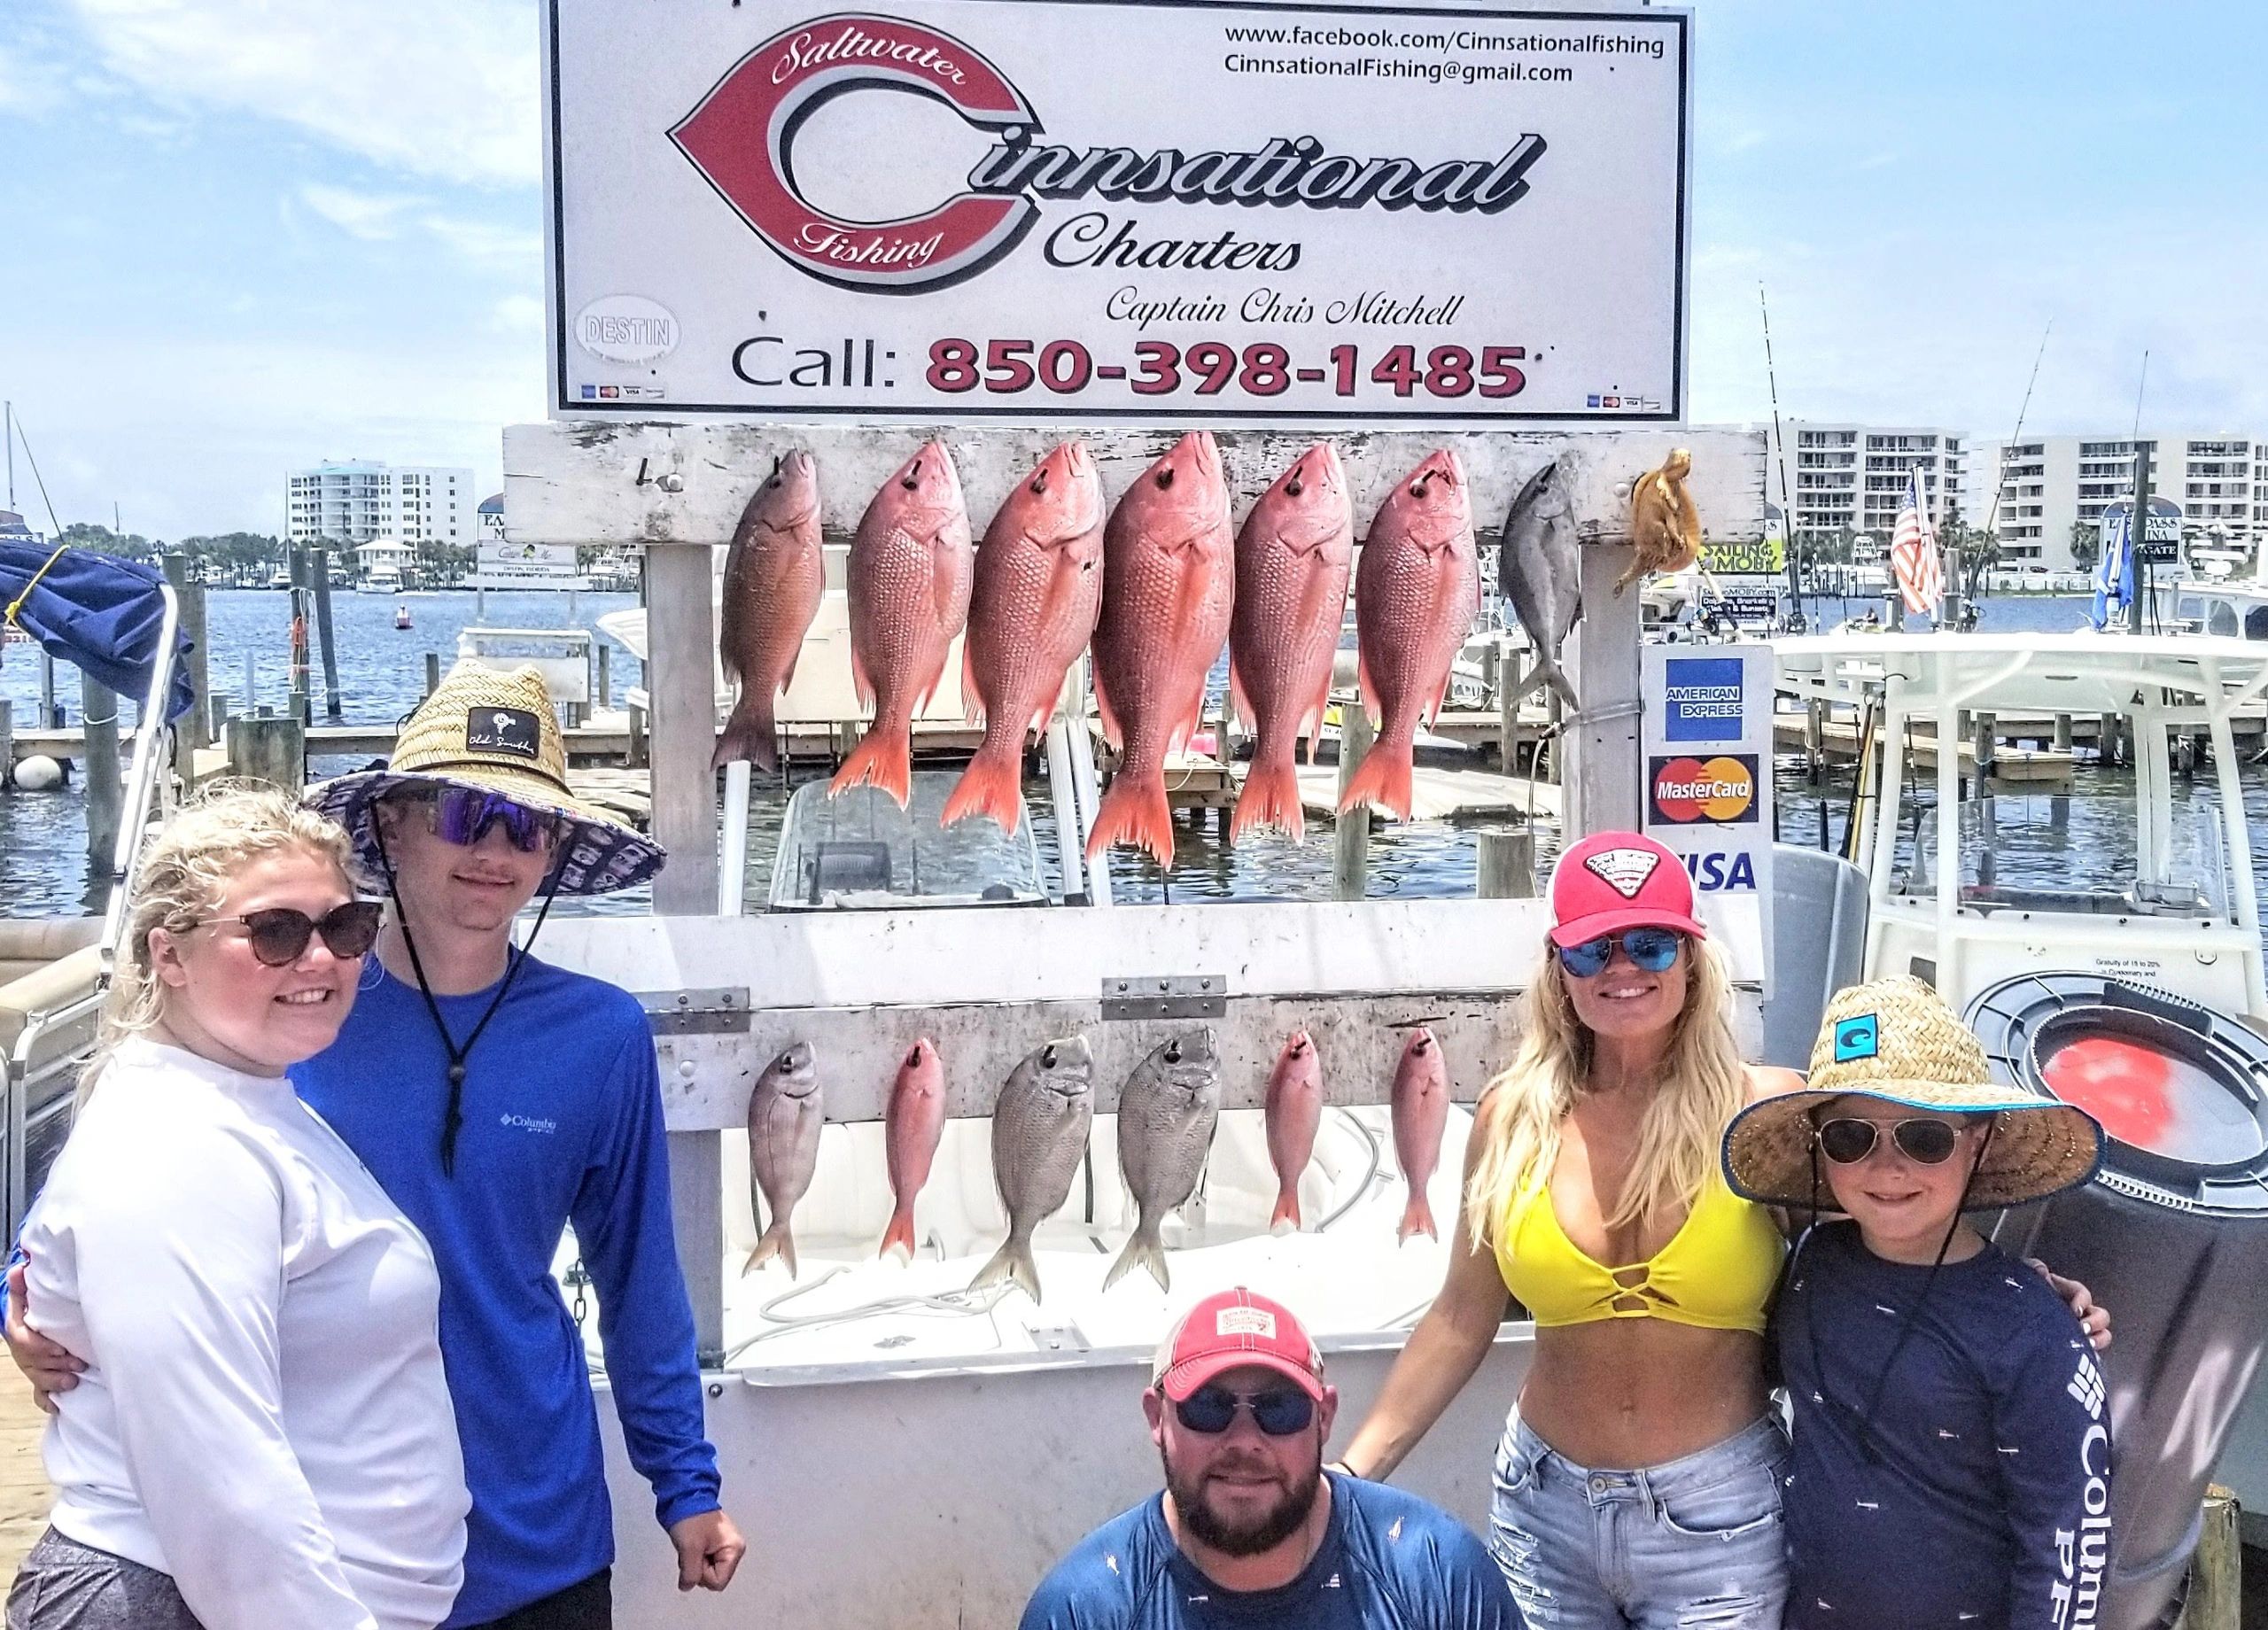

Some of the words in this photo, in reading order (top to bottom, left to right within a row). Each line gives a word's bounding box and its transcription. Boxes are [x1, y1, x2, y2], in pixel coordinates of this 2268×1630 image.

[772, 27, 967, 87] Saltwater
[1224, 26, 1665, 58] www.facebook.com/Cinnsationalfishing
[1224, 54, 1573, 84] CinnsationalFishing@gmail.com
[794, 221, 944, 269] Fishing
[1043, 211, 1301, 272] Charters
[1106, 284, 1228, 330] Captain
[1239, 286, 1315, 324] Chris
[1325, 289, 1465, 327] Mitchell
[586, 315, 670, 346] DESTIN
[731, 336, 896, 388] Call:
[925, 338, 1526, 399] 850-398-1485
[1704, 543, 1774, 557] SAILING
[1715, 556, 1777, 571] MOBY
[1666, 688, 1738, 700] AMERICAN
[1682, 704, 1744, 717] EXPRESS
[1658, 780, 1750, 800] MasterCard
[1679, 852, 1757, 891] ISA
[2070, 1424, 2112, 1630] Colum
